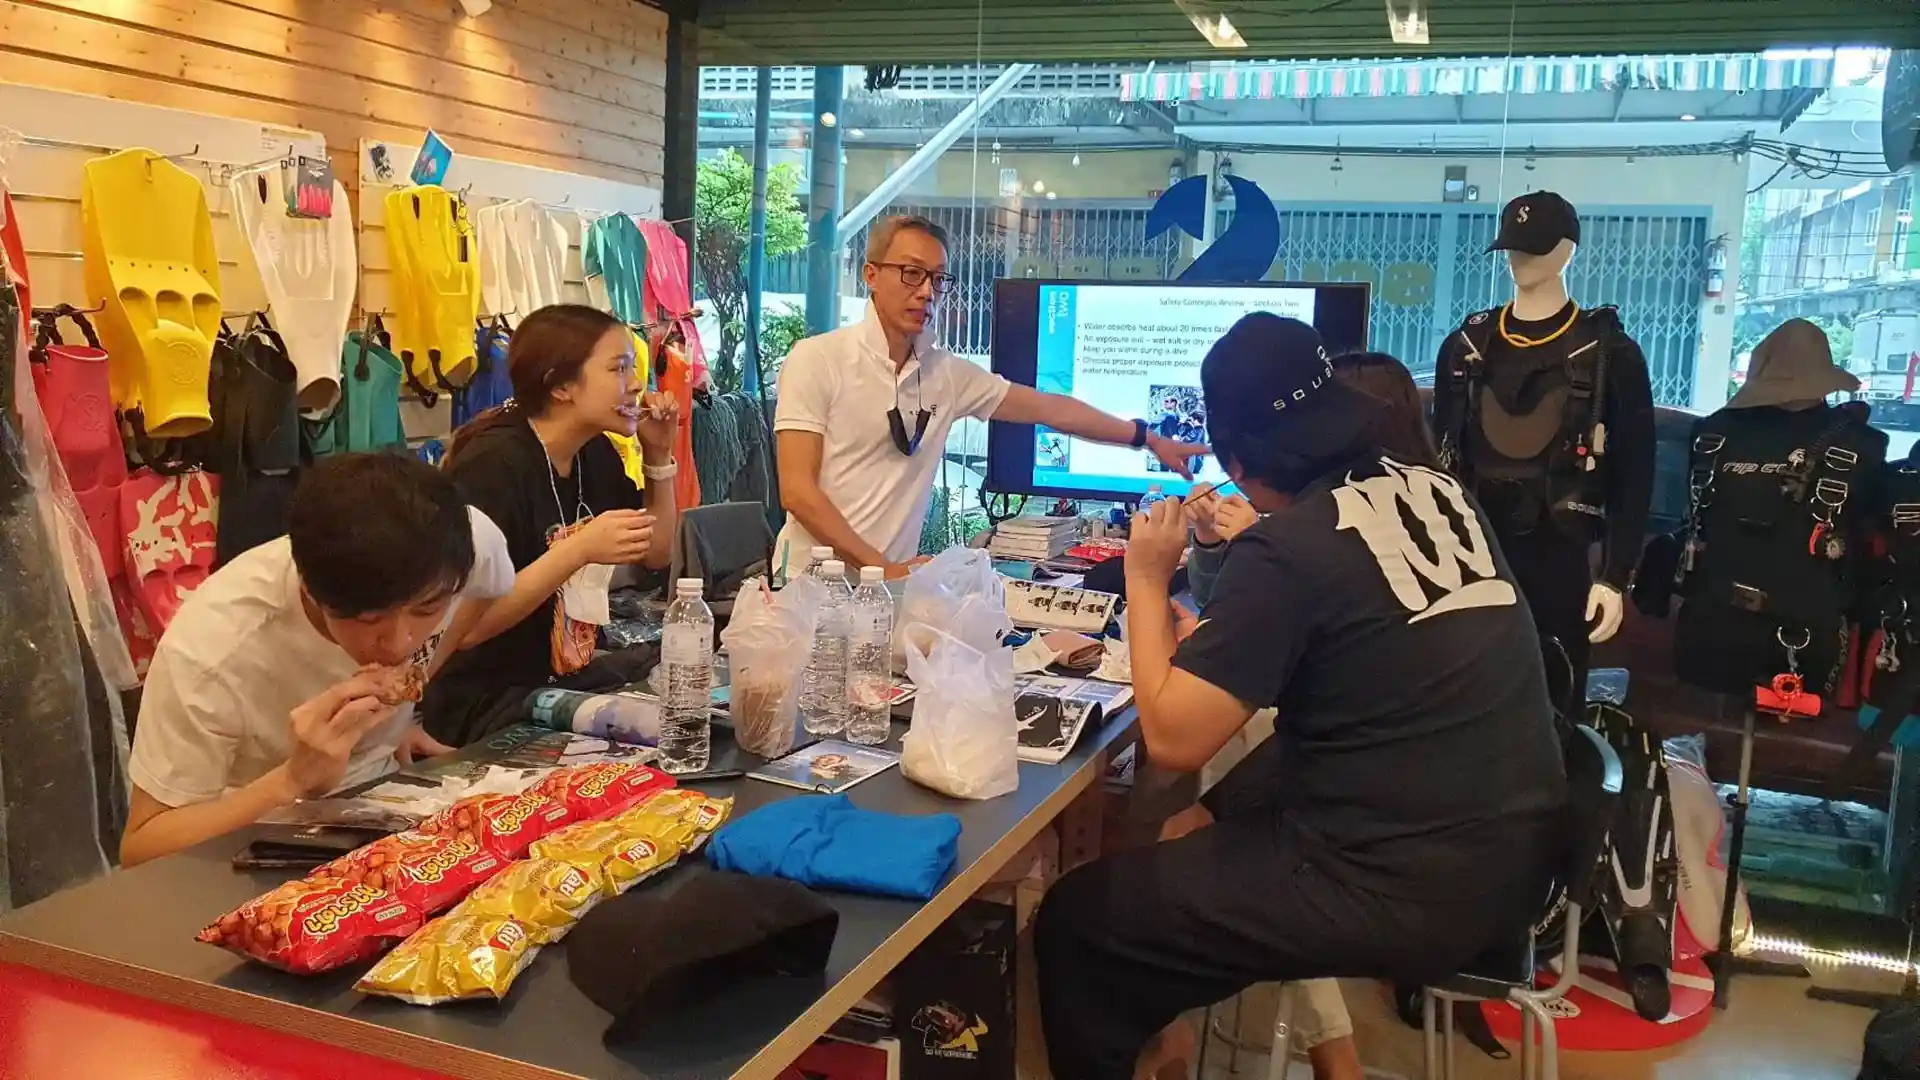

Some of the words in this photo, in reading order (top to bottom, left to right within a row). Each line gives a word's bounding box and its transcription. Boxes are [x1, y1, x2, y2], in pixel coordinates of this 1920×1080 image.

[1083, 322, 1105, 331] Water
[1156, 324, 1178, 333] about
[1179, 325, 1190, 333] 20
[1095, 336, 1129, 346] exposure
[1102, 347, 1116, 355] you
[1138, 359, 1173, 369] exposure
